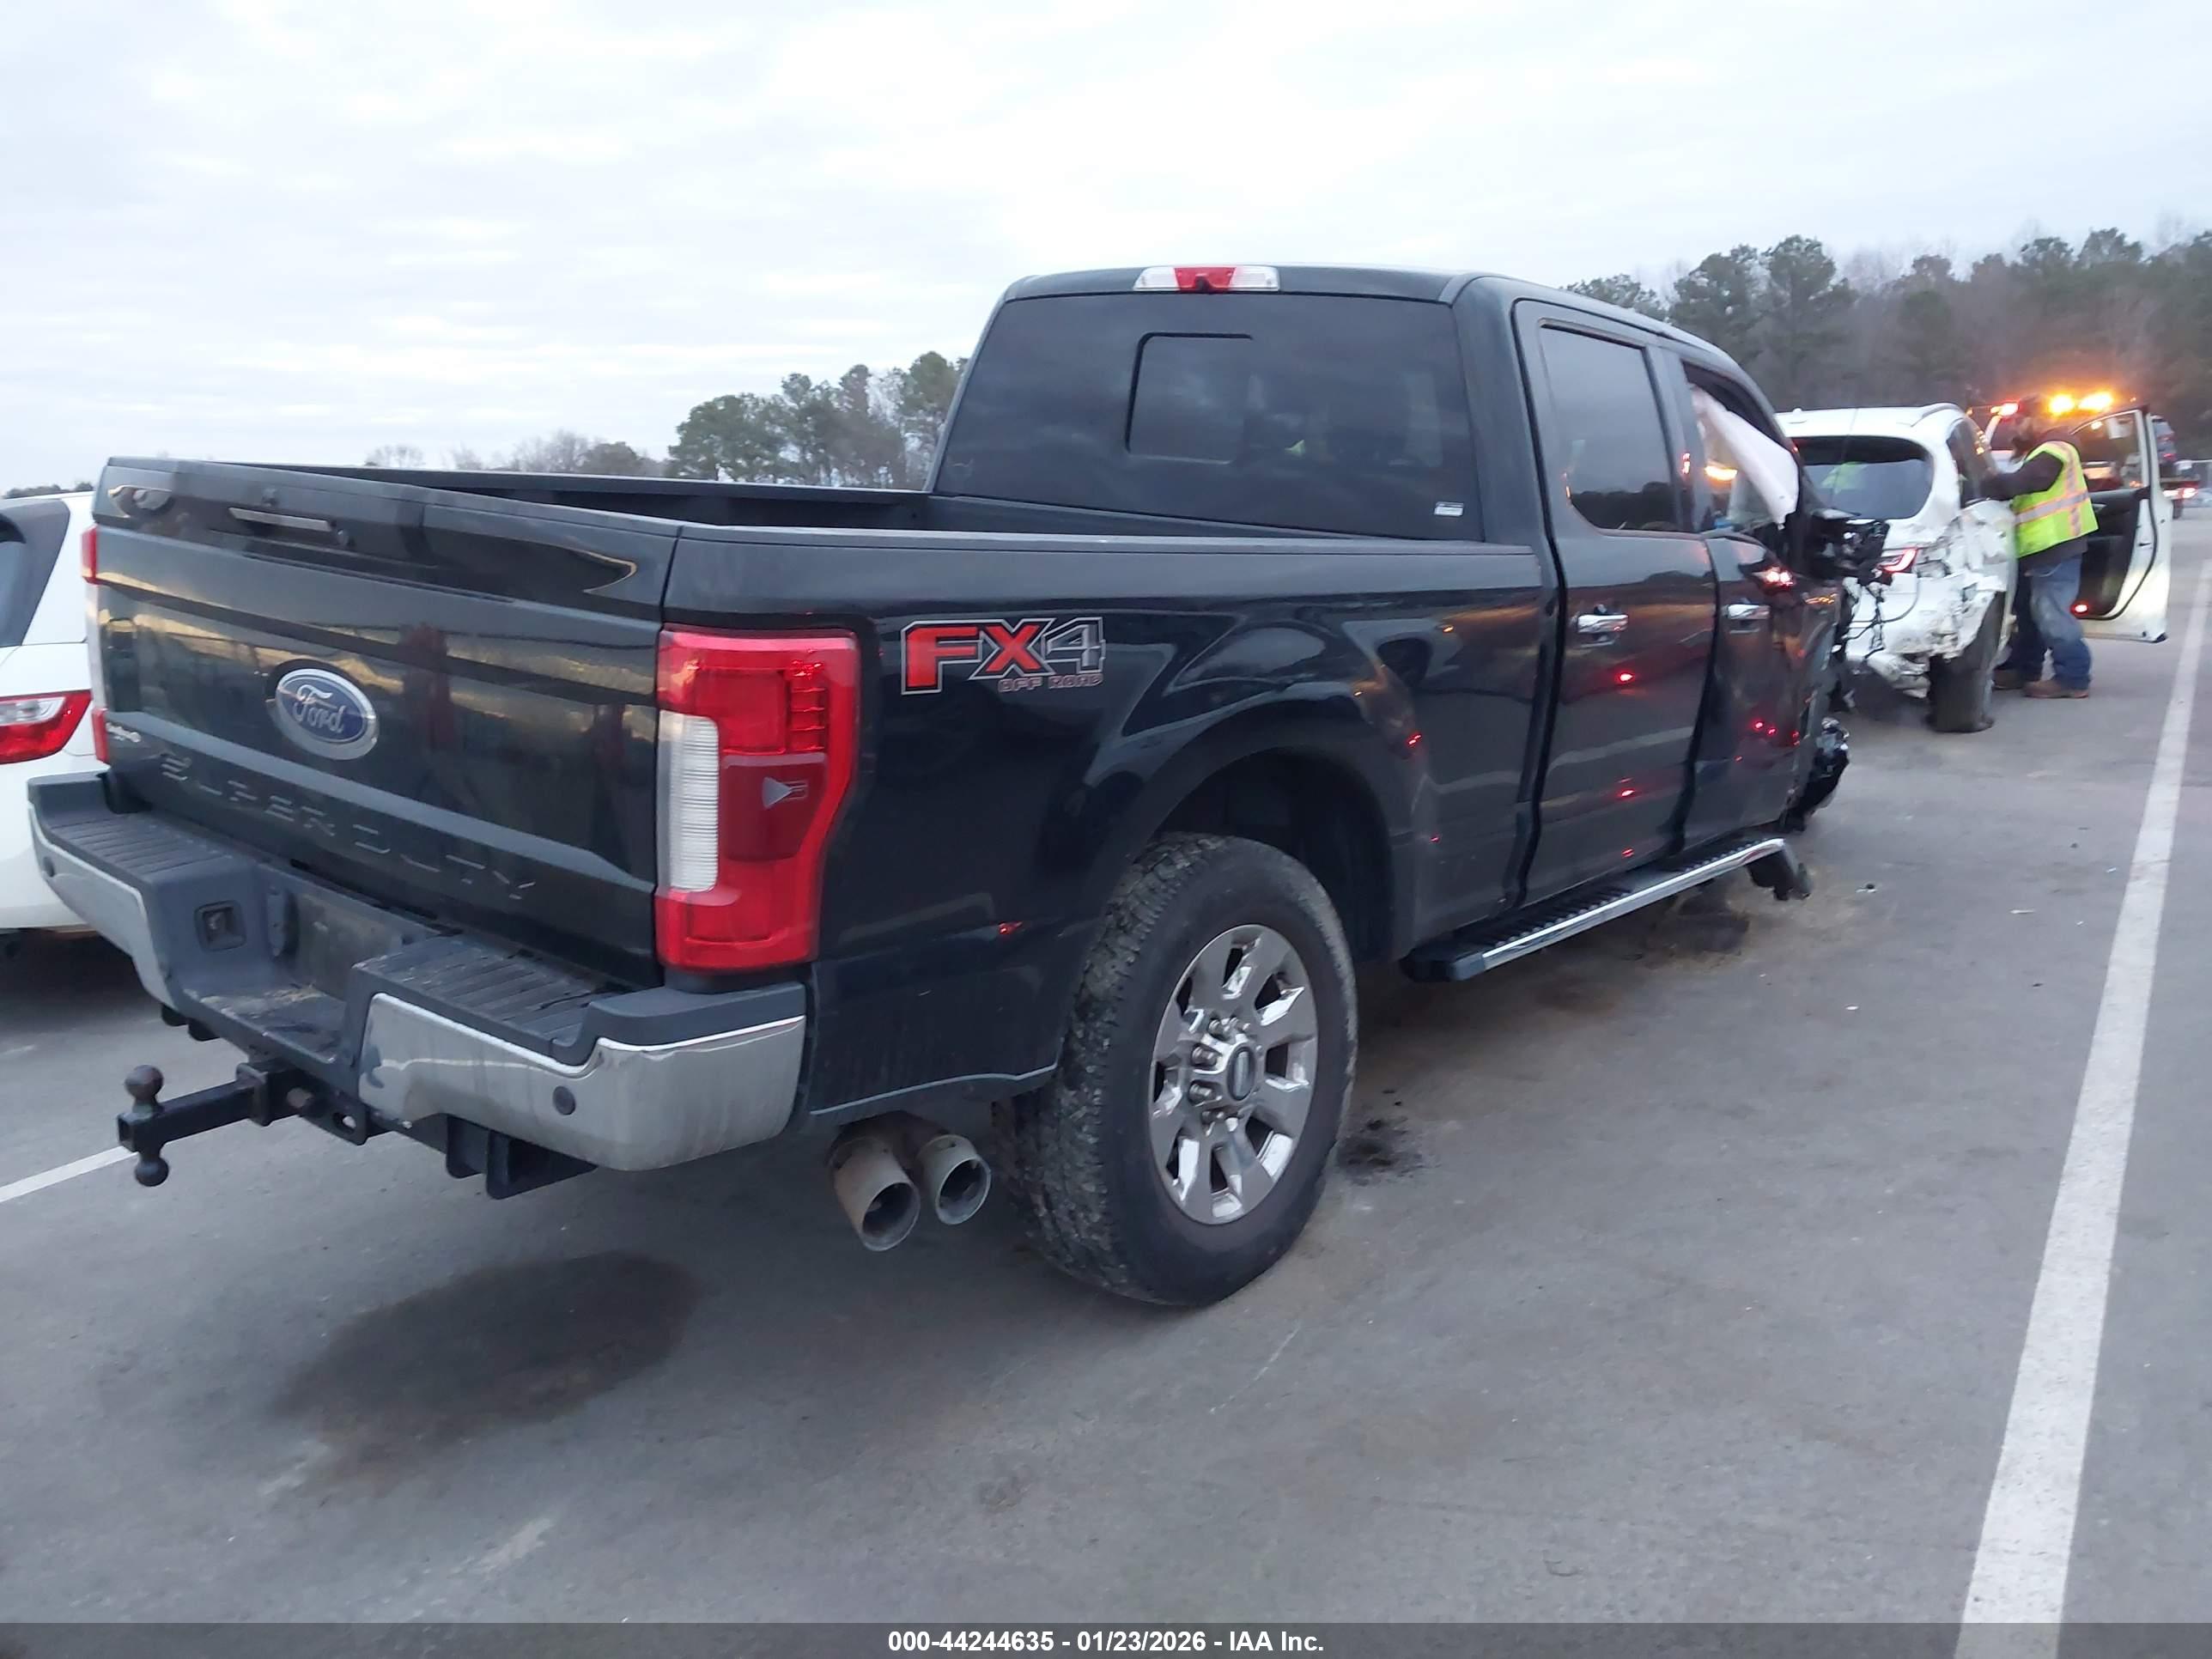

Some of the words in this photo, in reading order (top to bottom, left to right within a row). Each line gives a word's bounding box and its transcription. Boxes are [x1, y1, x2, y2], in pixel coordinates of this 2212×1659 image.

[901, 617, 1107, 696] FX4
[997, 676, 1043, 692] OFF
[1048, 672, 1104, 690] ROAD
[293, 684, 347, 733] Ford
[161, 753, 337, 838] SPER
[351, 823, 537, 902] DTY
